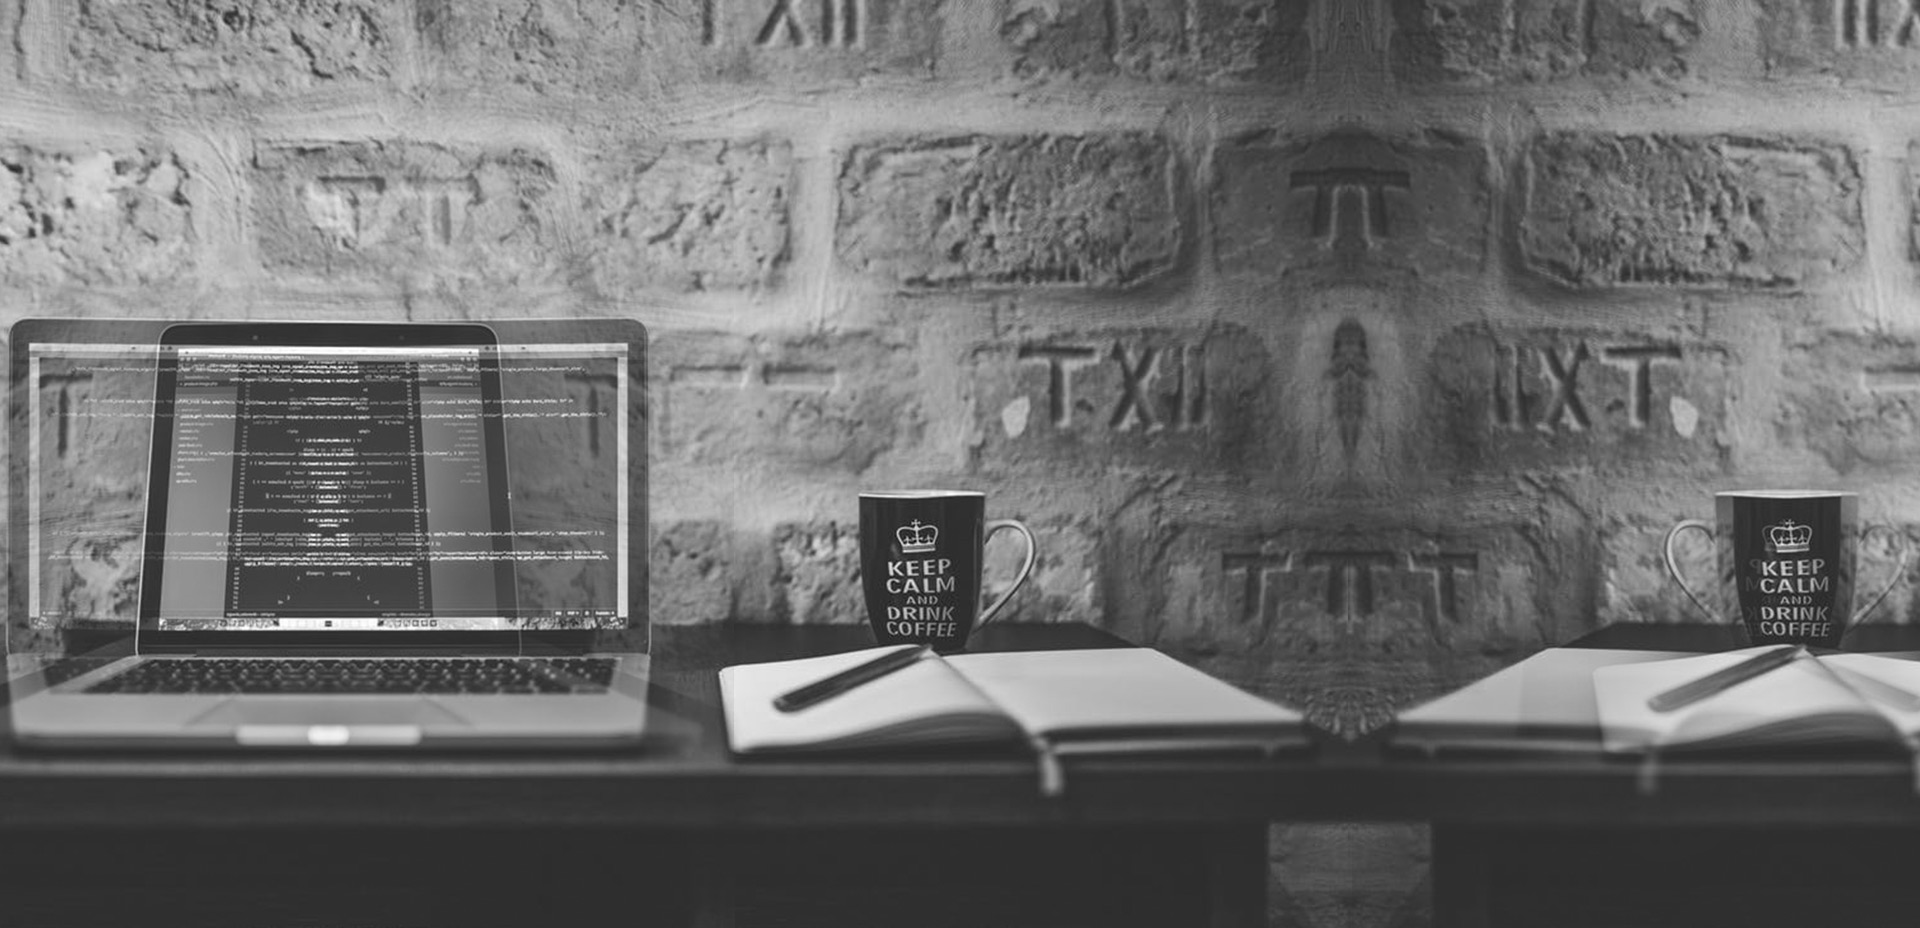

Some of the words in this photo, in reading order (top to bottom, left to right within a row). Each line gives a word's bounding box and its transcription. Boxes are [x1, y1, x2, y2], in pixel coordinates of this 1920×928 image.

[887, 558, 951, 577] KEEP
[1762, 558, 1825, 576] KEEP
[886, 576, 956, 594] CALM
[1760, 576, 1829, 594] CALM
[906, 596, 938, 605] AND
[1780, 595, 1812, 605] AND
[887, 606, 955, 622] DRINK
[1761, 606, 1829, 621] DRINK
[886, 622, 957, 637] COFFEE
[1761, 621, 1831, 637] COFFEE
